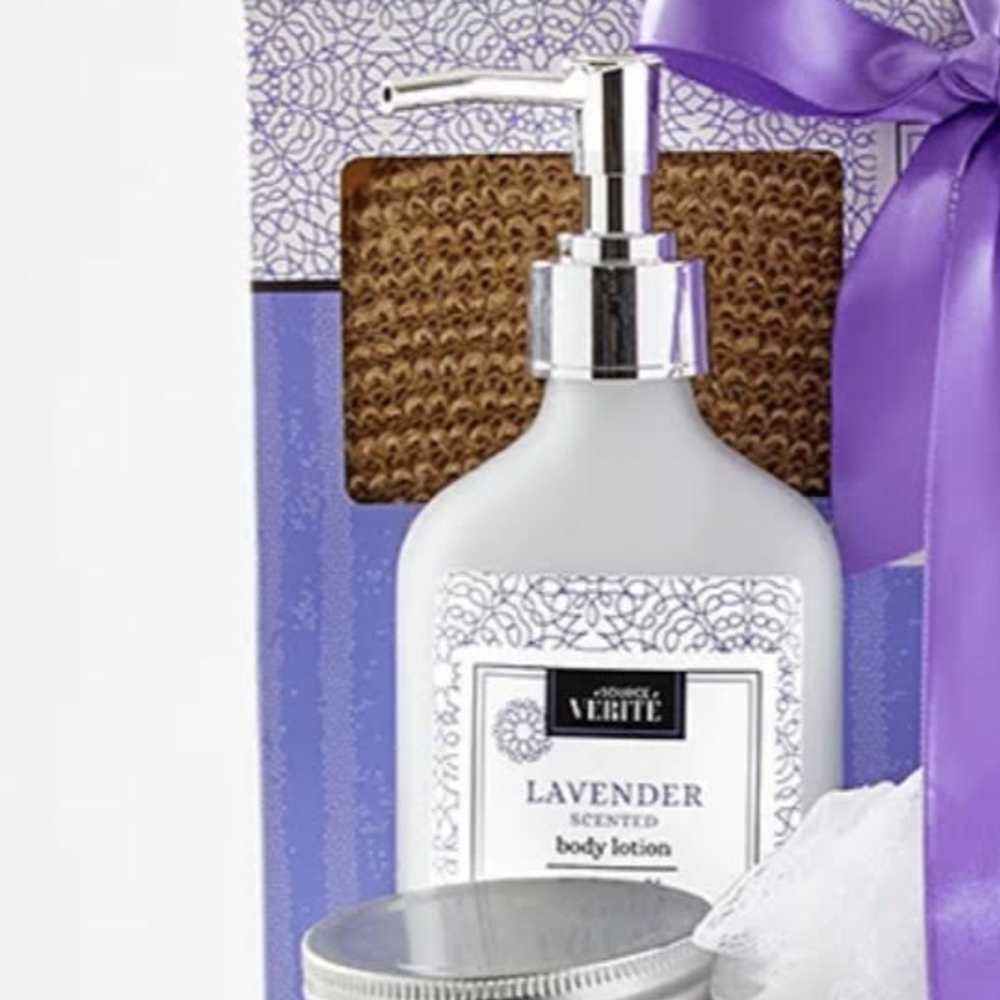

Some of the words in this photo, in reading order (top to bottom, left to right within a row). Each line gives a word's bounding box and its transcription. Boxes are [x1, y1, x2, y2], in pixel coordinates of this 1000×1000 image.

[525, 779, 704, 808] LAVENDER
[570, 812, 659, 829] SCENTED
[555, 835, 606, 861] body
[611, 836, 672, 857] lotion
